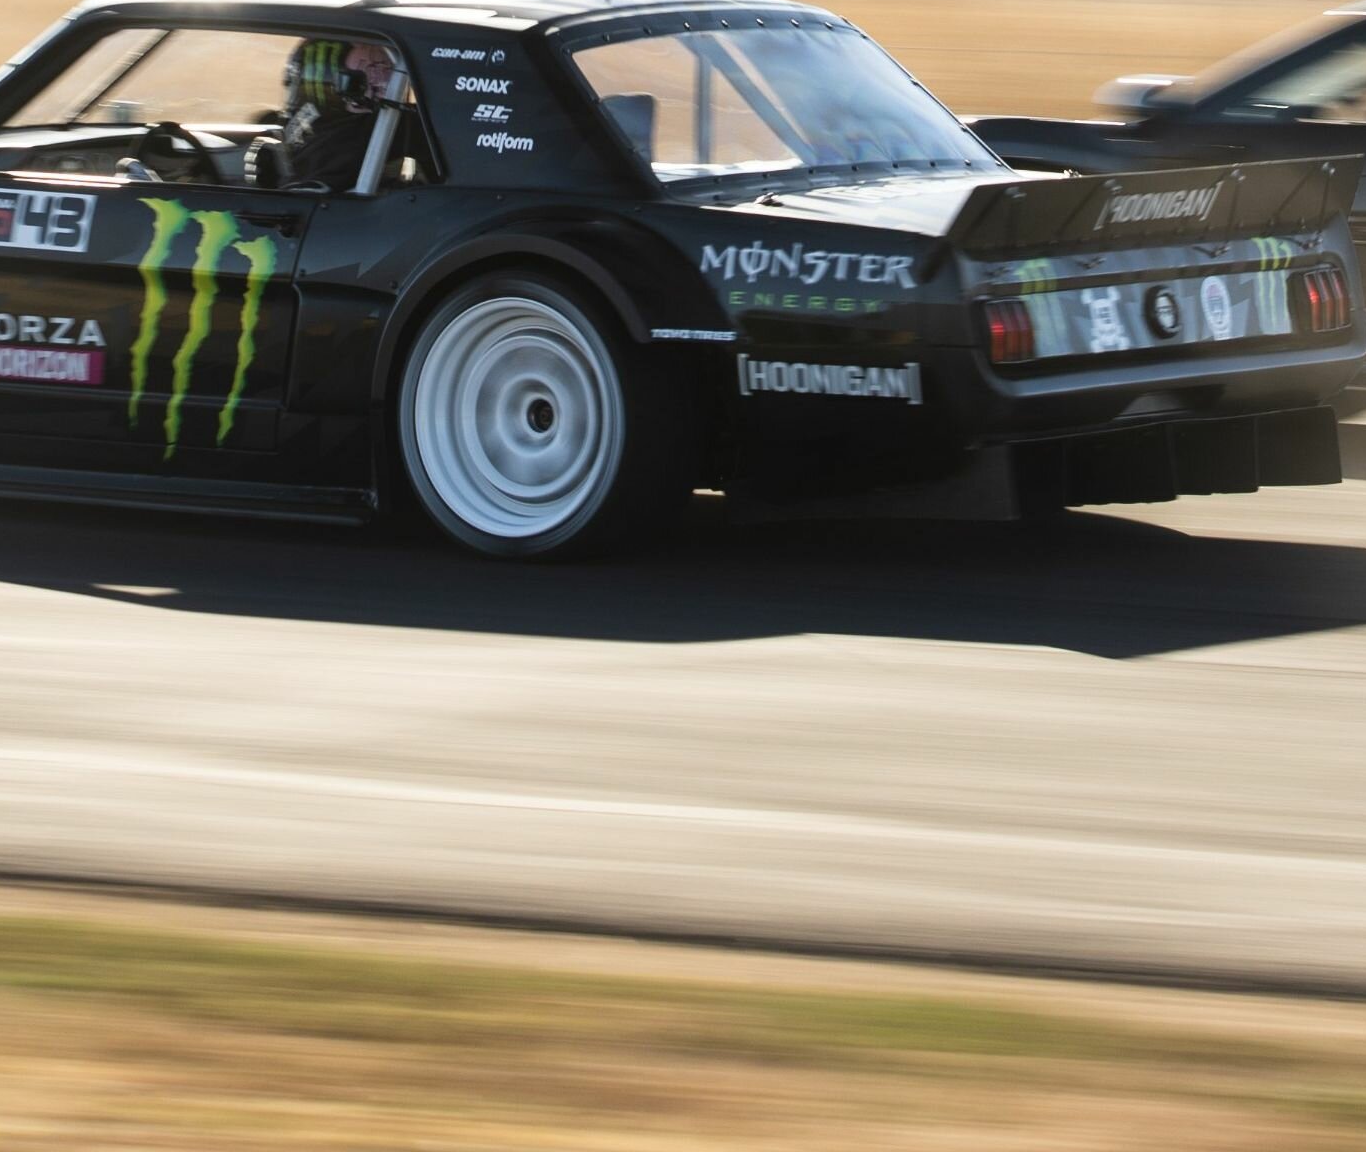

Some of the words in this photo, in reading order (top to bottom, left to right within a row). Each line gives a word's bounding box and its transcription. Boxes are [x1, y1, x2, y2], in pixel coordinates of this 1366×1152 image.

[455, 76, 509, 95] SONAX
[476, 132, 534, 154] rotiform
[23, 196, 86, 248] 43
[729, 291, 882, 313] ENERGY
